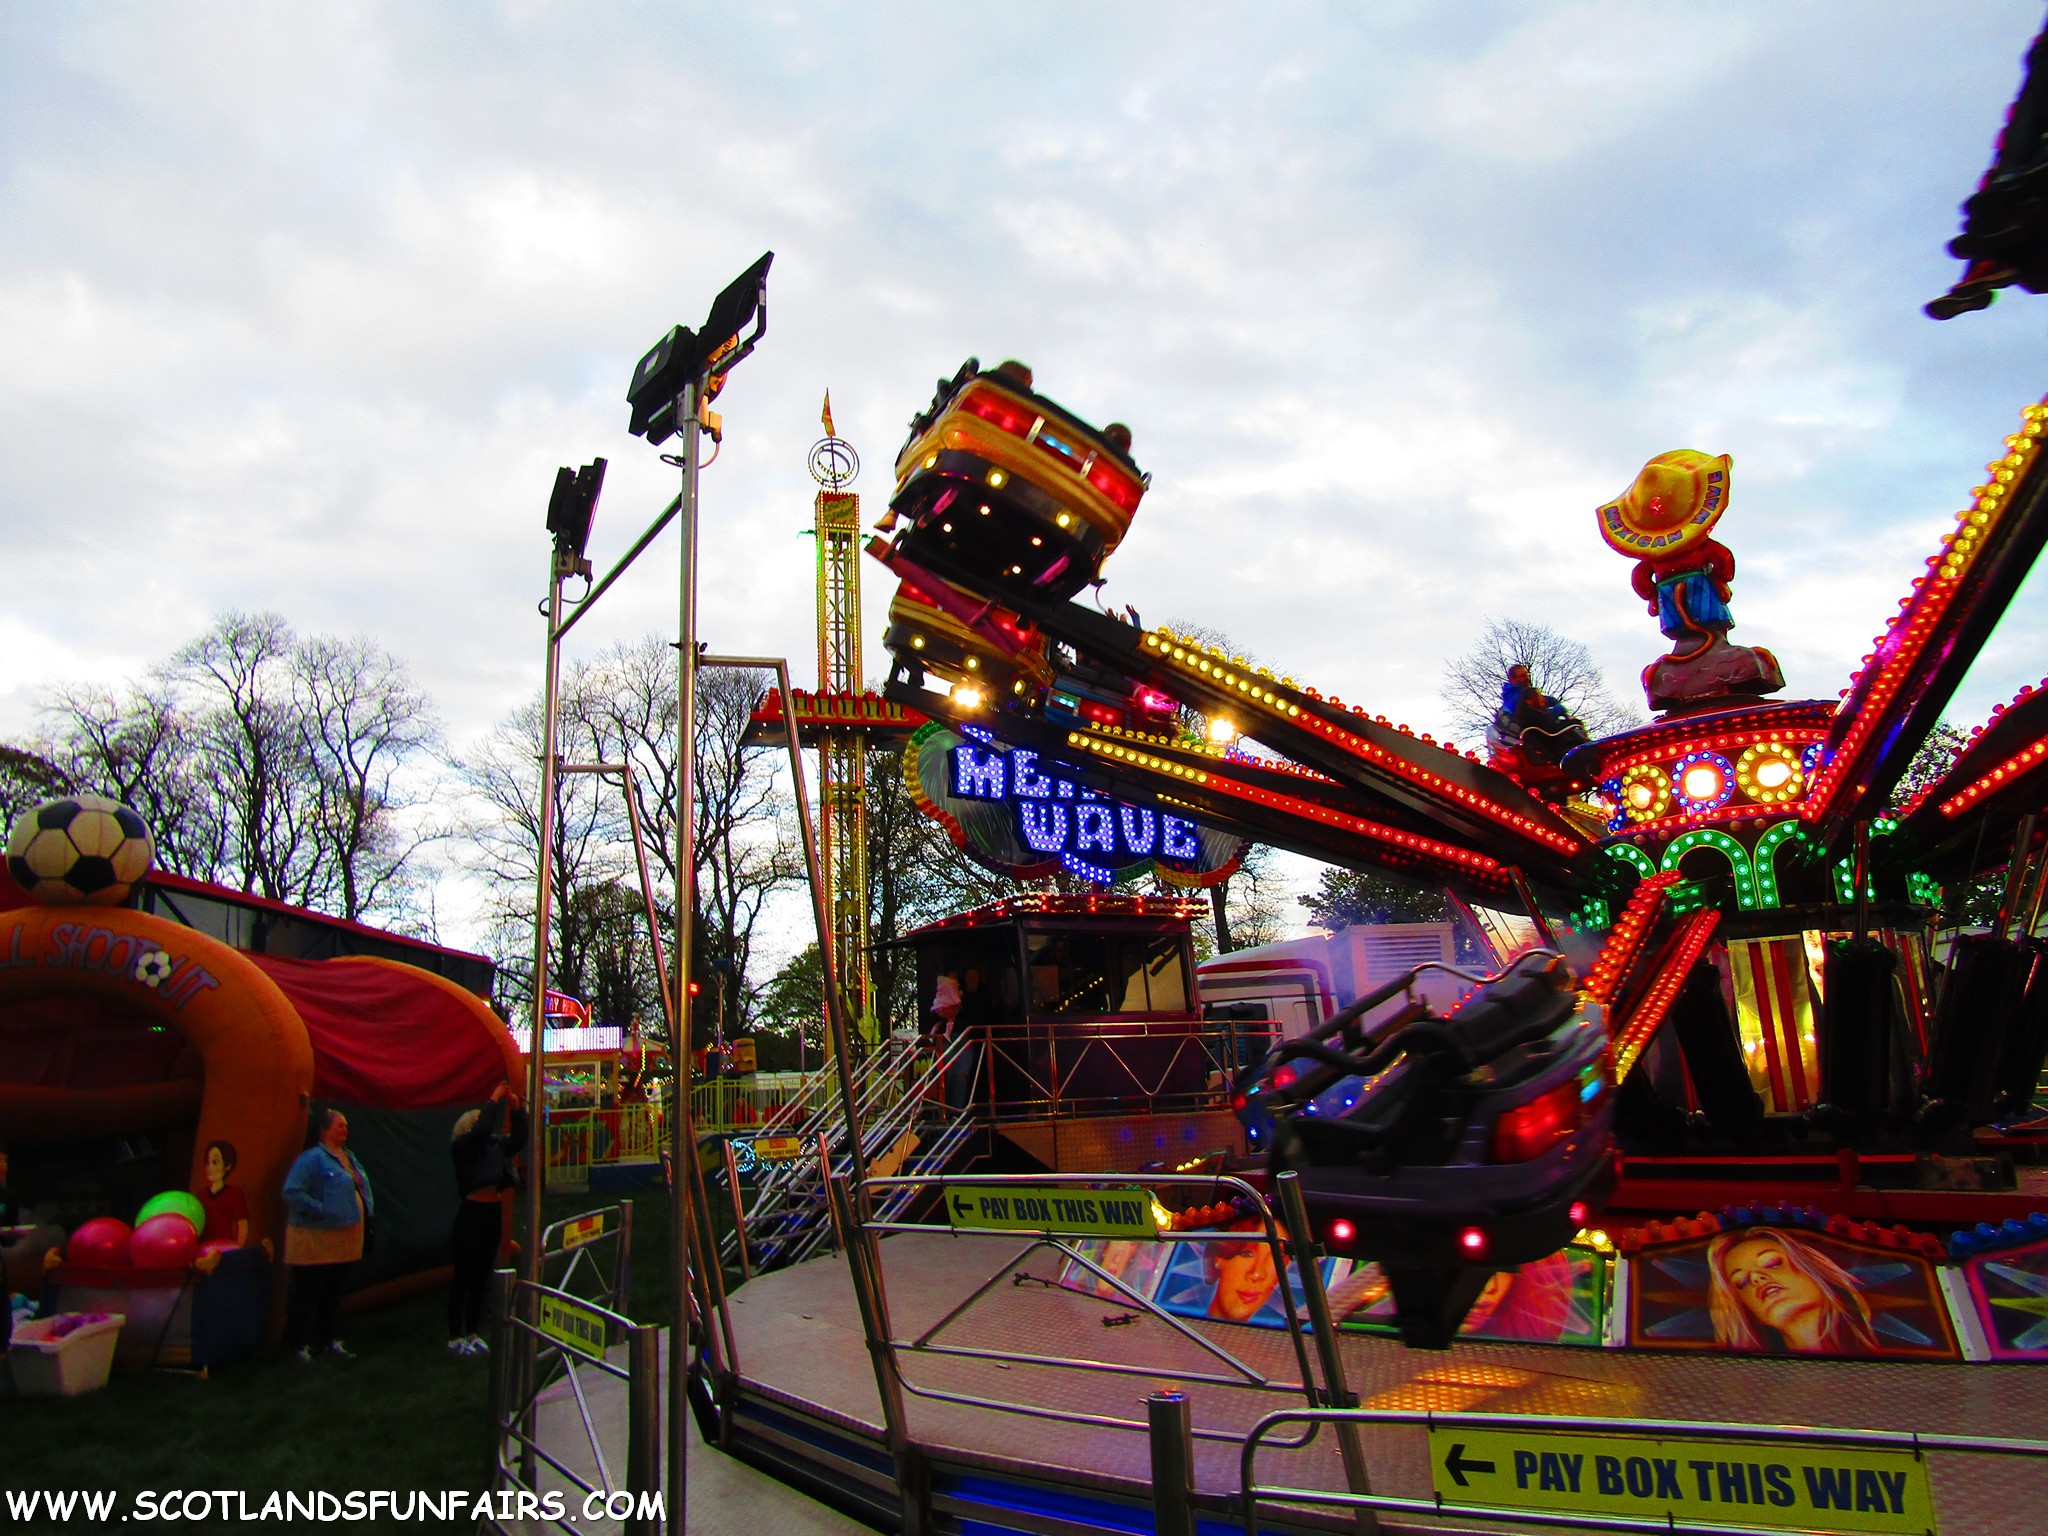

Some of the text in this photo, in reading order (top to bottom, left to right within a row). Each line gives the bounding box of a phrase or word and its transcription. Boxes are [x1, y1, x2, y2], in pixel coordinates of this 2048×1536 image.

[1604, 470, 1723, 548] MEXICAN WAVE
[1019, 800, 1198, 860] WAVE
[979, 1196, 1145, 1226] PAY BOX THIS WAY
[1513, 1449, 1908, 1515] PAY BOX THIS WAY
